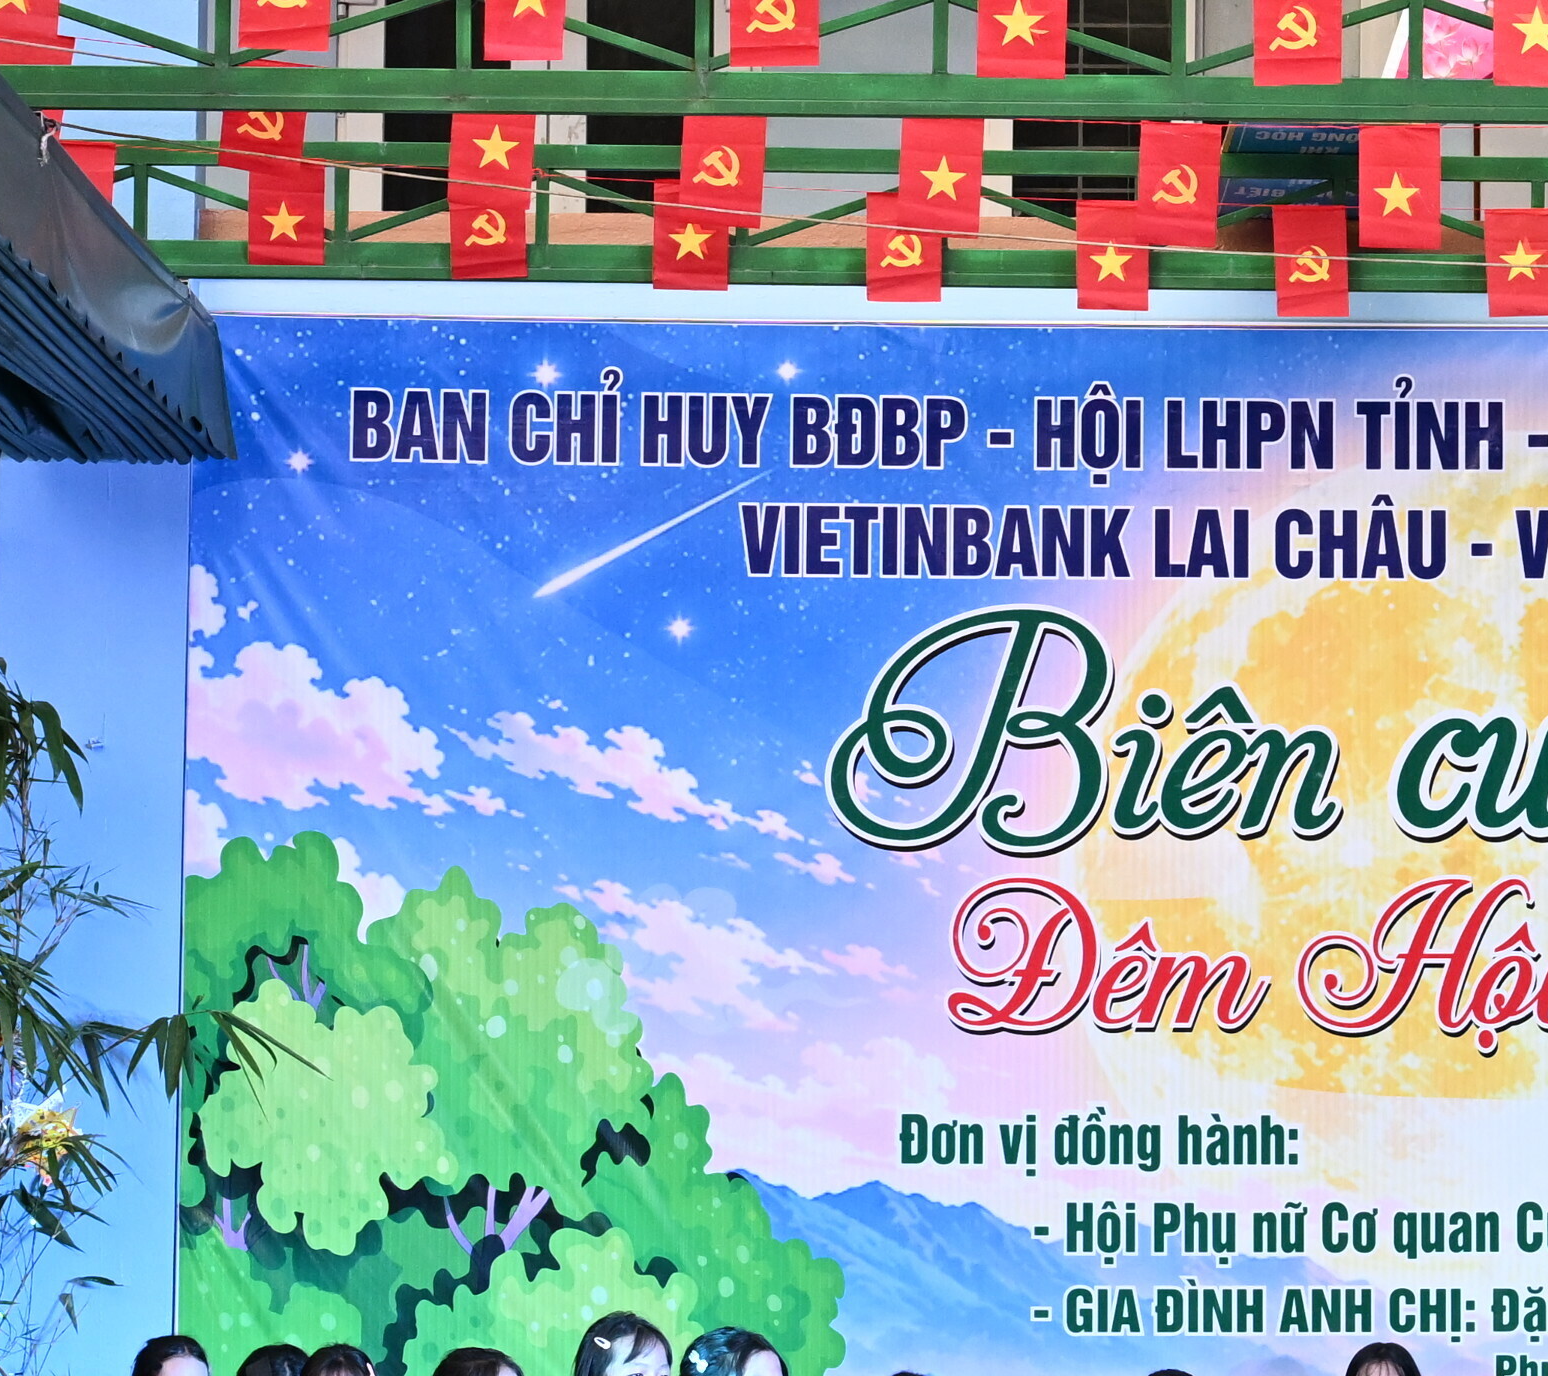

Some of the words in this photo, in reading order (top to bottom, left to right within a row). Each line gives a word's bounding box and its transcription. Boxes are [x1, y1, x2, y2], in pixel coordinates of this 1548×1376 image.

[352, 389, 488, 463] BAN
[512, 369, 623, 466] CHỈ
[642, 393, 772, 468] HUY
[792, 396, 965, 470] BĐBP
[1035, 382, 1143, 487] HỘI
[1166, 399, 1335, 470] LHPN
[1357, 376, 1504, 471] TỈNH
[741, 505, 1131, 578] VIETINBANK
[1156, 507, 1248, 578] LAI
[1274, 495, 1447, 580] CHÂU
[827, 605, 1342, 856] Biên
[947, 877, 1268, 1037] Đêm
[900, 1114, 984, 1165] Đơn
[999, 1116, 1038, 1176] vị
[1053, 1103, 1162, 1170] đồng
[1178, 1114, 1300, 1165] hành:
[1066, 1202, 1137, 1266] Hội
[1155, 1202, 1236, 1266] Phụ
[1253, 1202, 1306, 1253] nữ
[1321, 1202, 1378, 1253] Cơ
[1393, 1214, 1500, 1262] quan
[1066, 1288, 1141, 1334] GIA
[1155, 1276, 1257, 1334] ĐÌNH
[1280, 1288, 1373, 1334] ANH
[1389, 1288, 1476, 1344] CHỊ:
